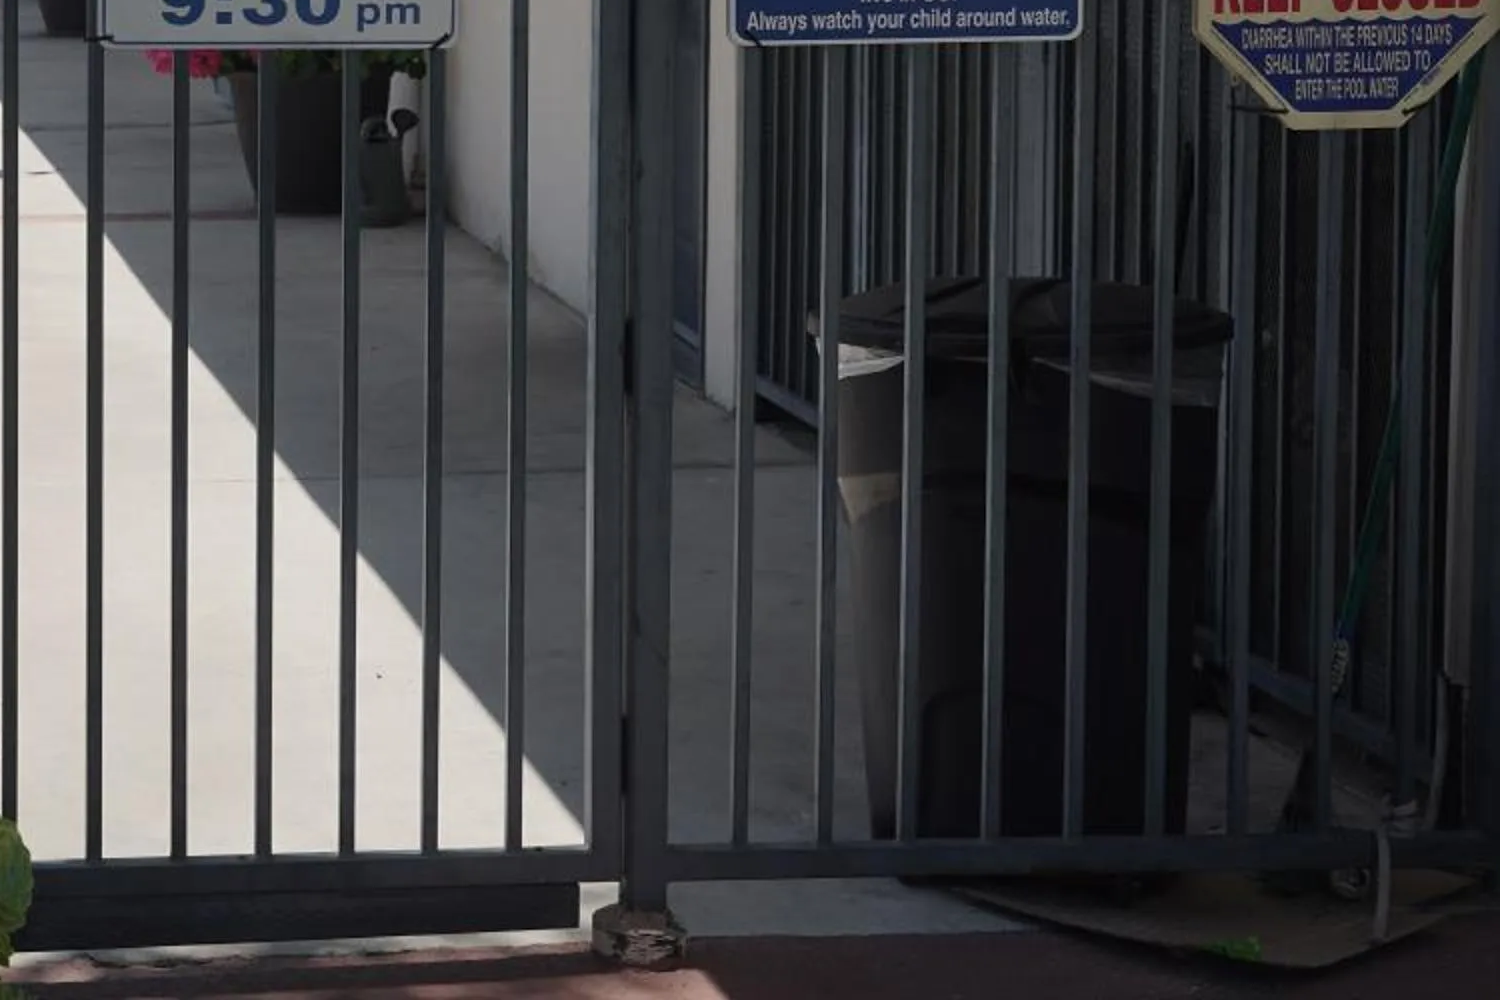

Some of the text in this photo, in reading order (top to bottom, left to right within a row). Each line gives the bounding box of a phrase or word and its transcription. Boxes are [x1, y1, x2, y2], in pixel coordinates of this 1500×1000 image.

[357, 2, 420, 31] pm
[747, 7, 1071, 36] Always watch your child around water.
[1241, 23, 1453, 50] DIARRHEA WITHIN THE PREVIOUS 14 DAYS
[1265, 50, 1431, 75] SHALL NOT BE ALLOWED TO
[1295, 77, 1399, 100] ENTER THE POOL WATER
